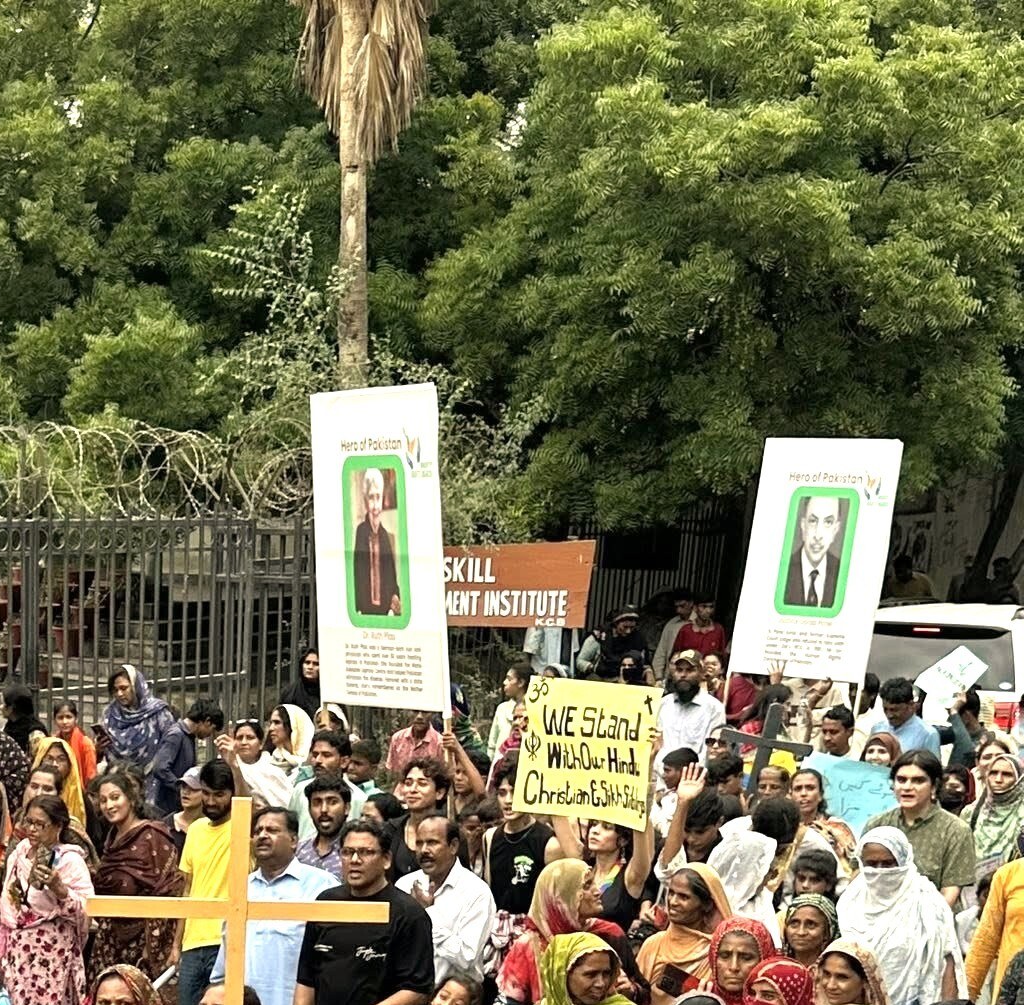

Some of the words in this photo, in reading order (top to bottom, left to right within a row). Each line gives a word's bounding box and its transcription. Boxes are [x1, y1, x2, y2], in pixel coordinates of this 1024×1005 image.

[341, 439, 358, 452] Hero
[359, 438, 367, 451] of
[369, 437, 402, 451] Pakistan
[789, 472, 810, 481] Hero
[812, 472, 821, 482] of
[823, 473, 863, 484] Pakistan
[443, 556, 496, 583] SKILL
[483, 590, 568, 616] INSTITUTE
[543, 705, 577, 737] WE
[580, 707, 642, 742] Stand
[523, 770, 590, 805] Christian
